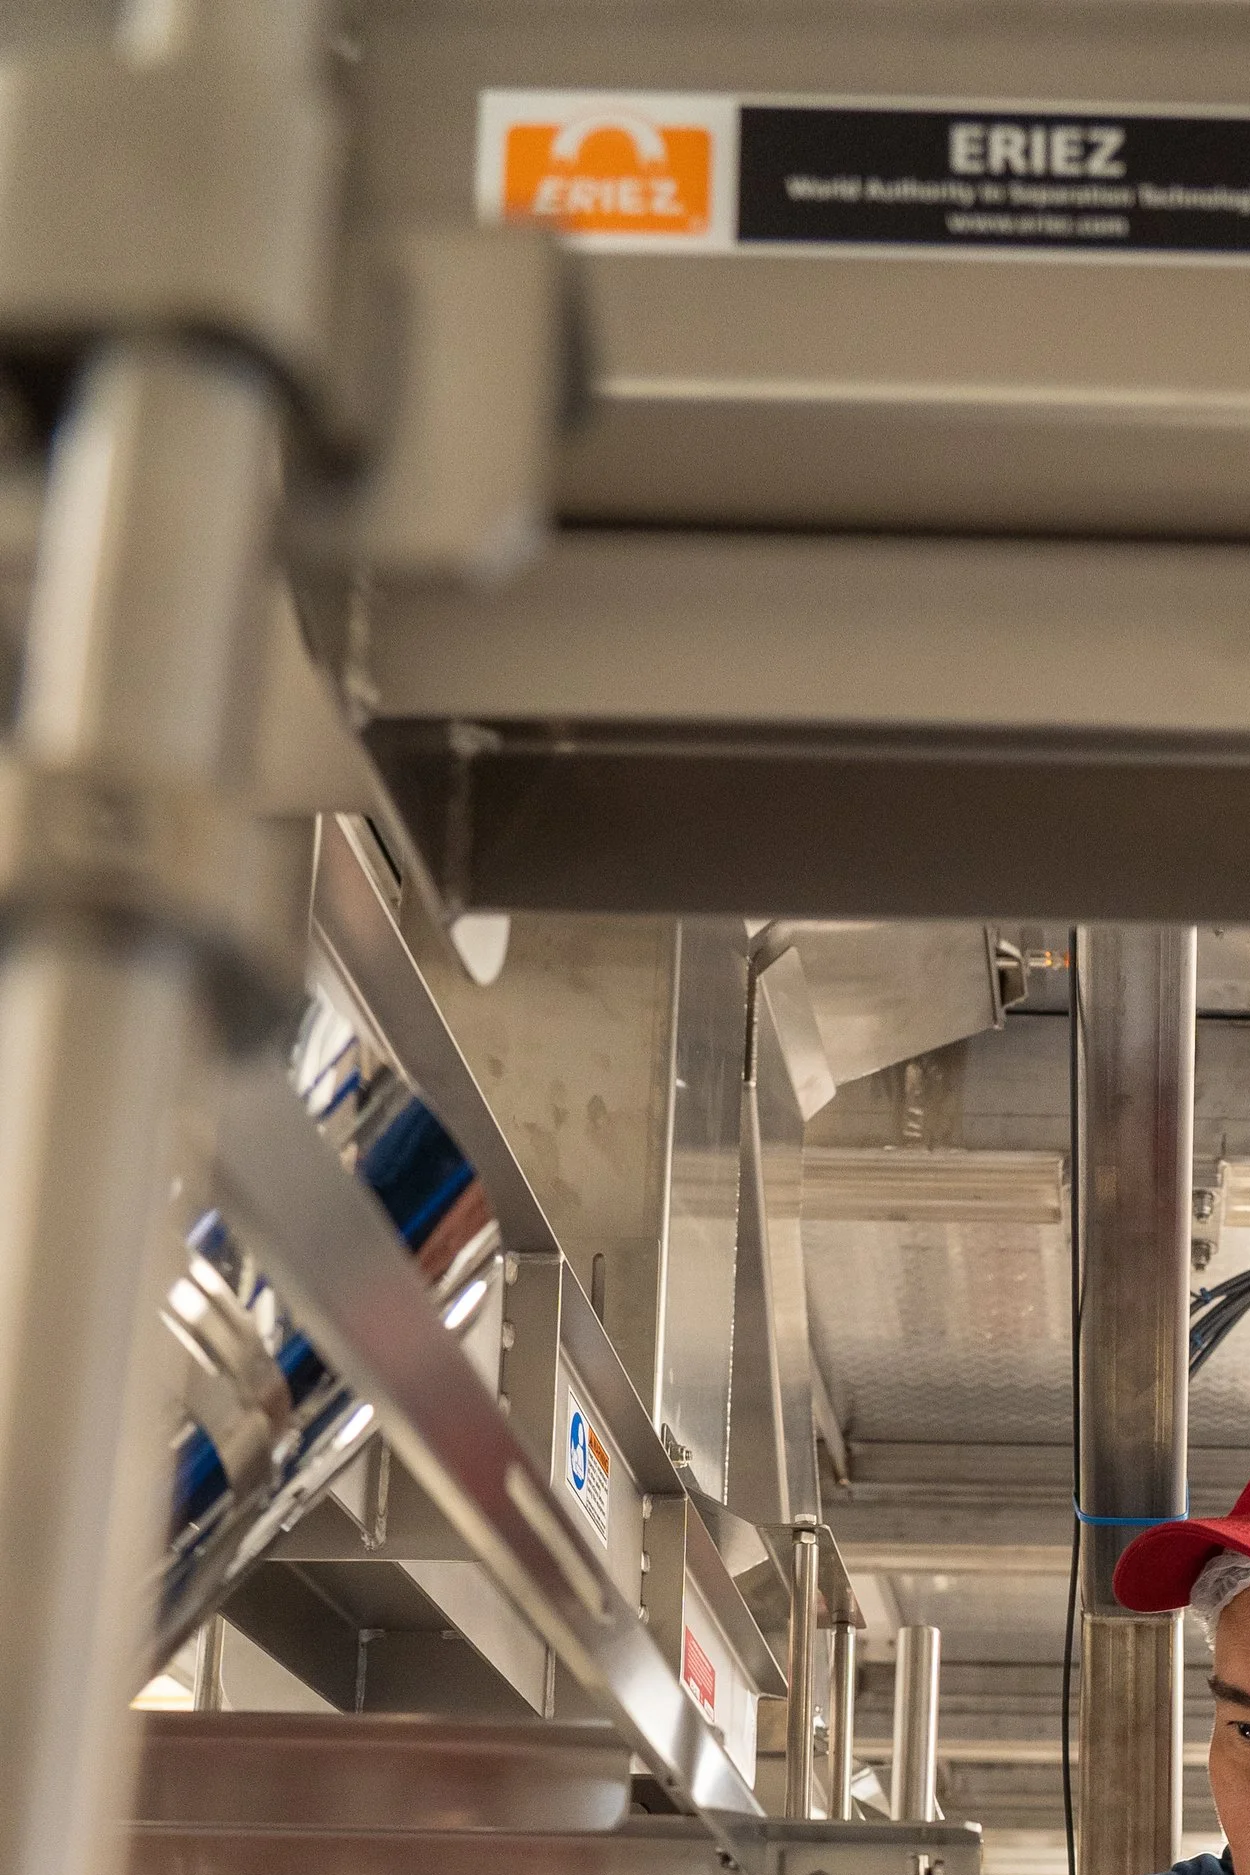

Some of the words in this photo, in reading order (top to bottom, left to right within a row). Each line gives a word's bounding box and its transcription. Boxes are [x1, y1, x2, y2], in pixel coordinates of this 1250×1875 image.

[950, 123, 1127, 177] ERIEZ
[532, 175, 685, 214] ERIEZ
[785, 175, 862, 202] World
[865, 177, 975, 207] Authority
